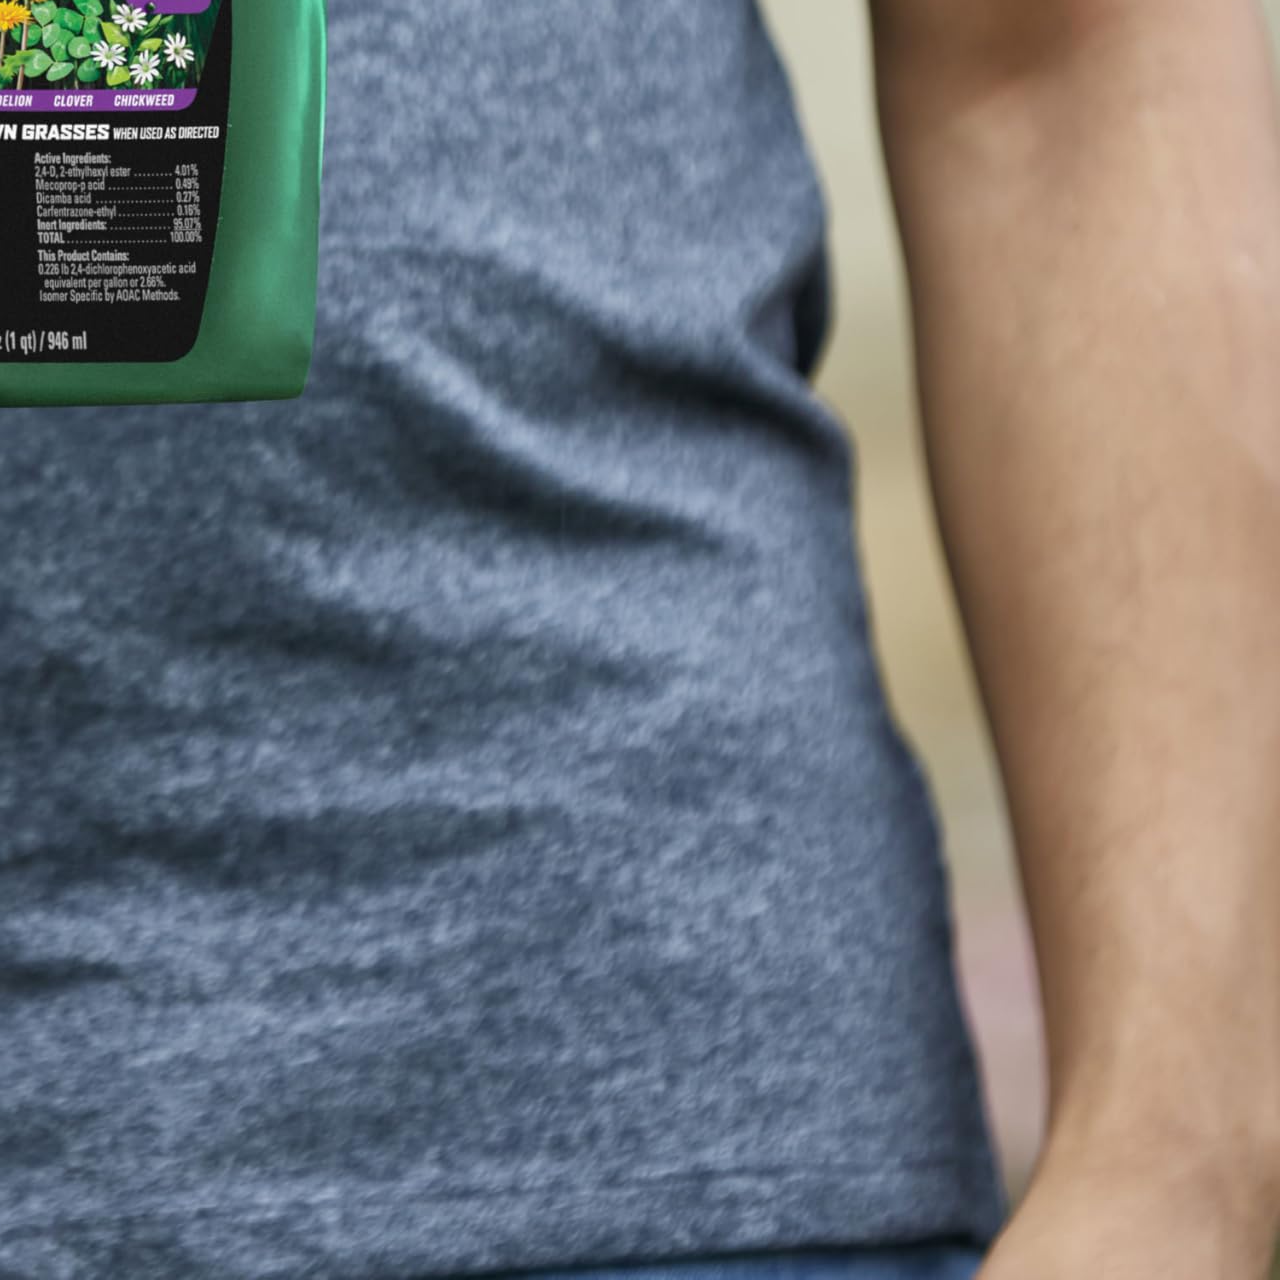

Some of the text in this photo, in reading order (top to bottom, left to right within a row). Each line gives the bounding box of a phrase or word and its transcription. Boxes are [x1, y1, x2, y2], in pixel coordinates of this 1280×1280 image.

[54, 94, 93, 108] CLOVER
[114, 94, 174, 107] CHICKWEED
[22, 124, 110, 140] GRASSES
[113, 128, 138, 140] WHEN
[140, 127, 162, 140] USED
[164, 127, 176, 139] AS
[178, 126, 219, 139] DIRECTED
[34, 152, 111, 165] Active Ingredients:
[110, 168, 131, 176] ester
[88, 180, 105, 190] acid
[36, 192, 72, 204] Dicamba
[74, 192, 91, 203] acid
[37, 220, 57, 230] Inert
[58, 220, 107, 232] Ingredients:
[38, 232, 65, 243] TOTAL
[38, 250, 129, 261] This Product Contains:
[61, 264, 69, 274] lb
[179, 262, 196, 273] acid
[44, 277, 86, 290] equivalent
[88, 279, 101, 289] per
[104, 277, 128, 289] gallon
[130, 279, 138, 287] or
[40, 290, 180, 304] Isomer Specific by AOAC Methods.
[5, 330, 15, 352] (1
[21, 330, 36, 355] qt)
[39, 331, 45, 352] /
[48, 332, 69, 350] 946
[72, 331, 87, 350] ml
